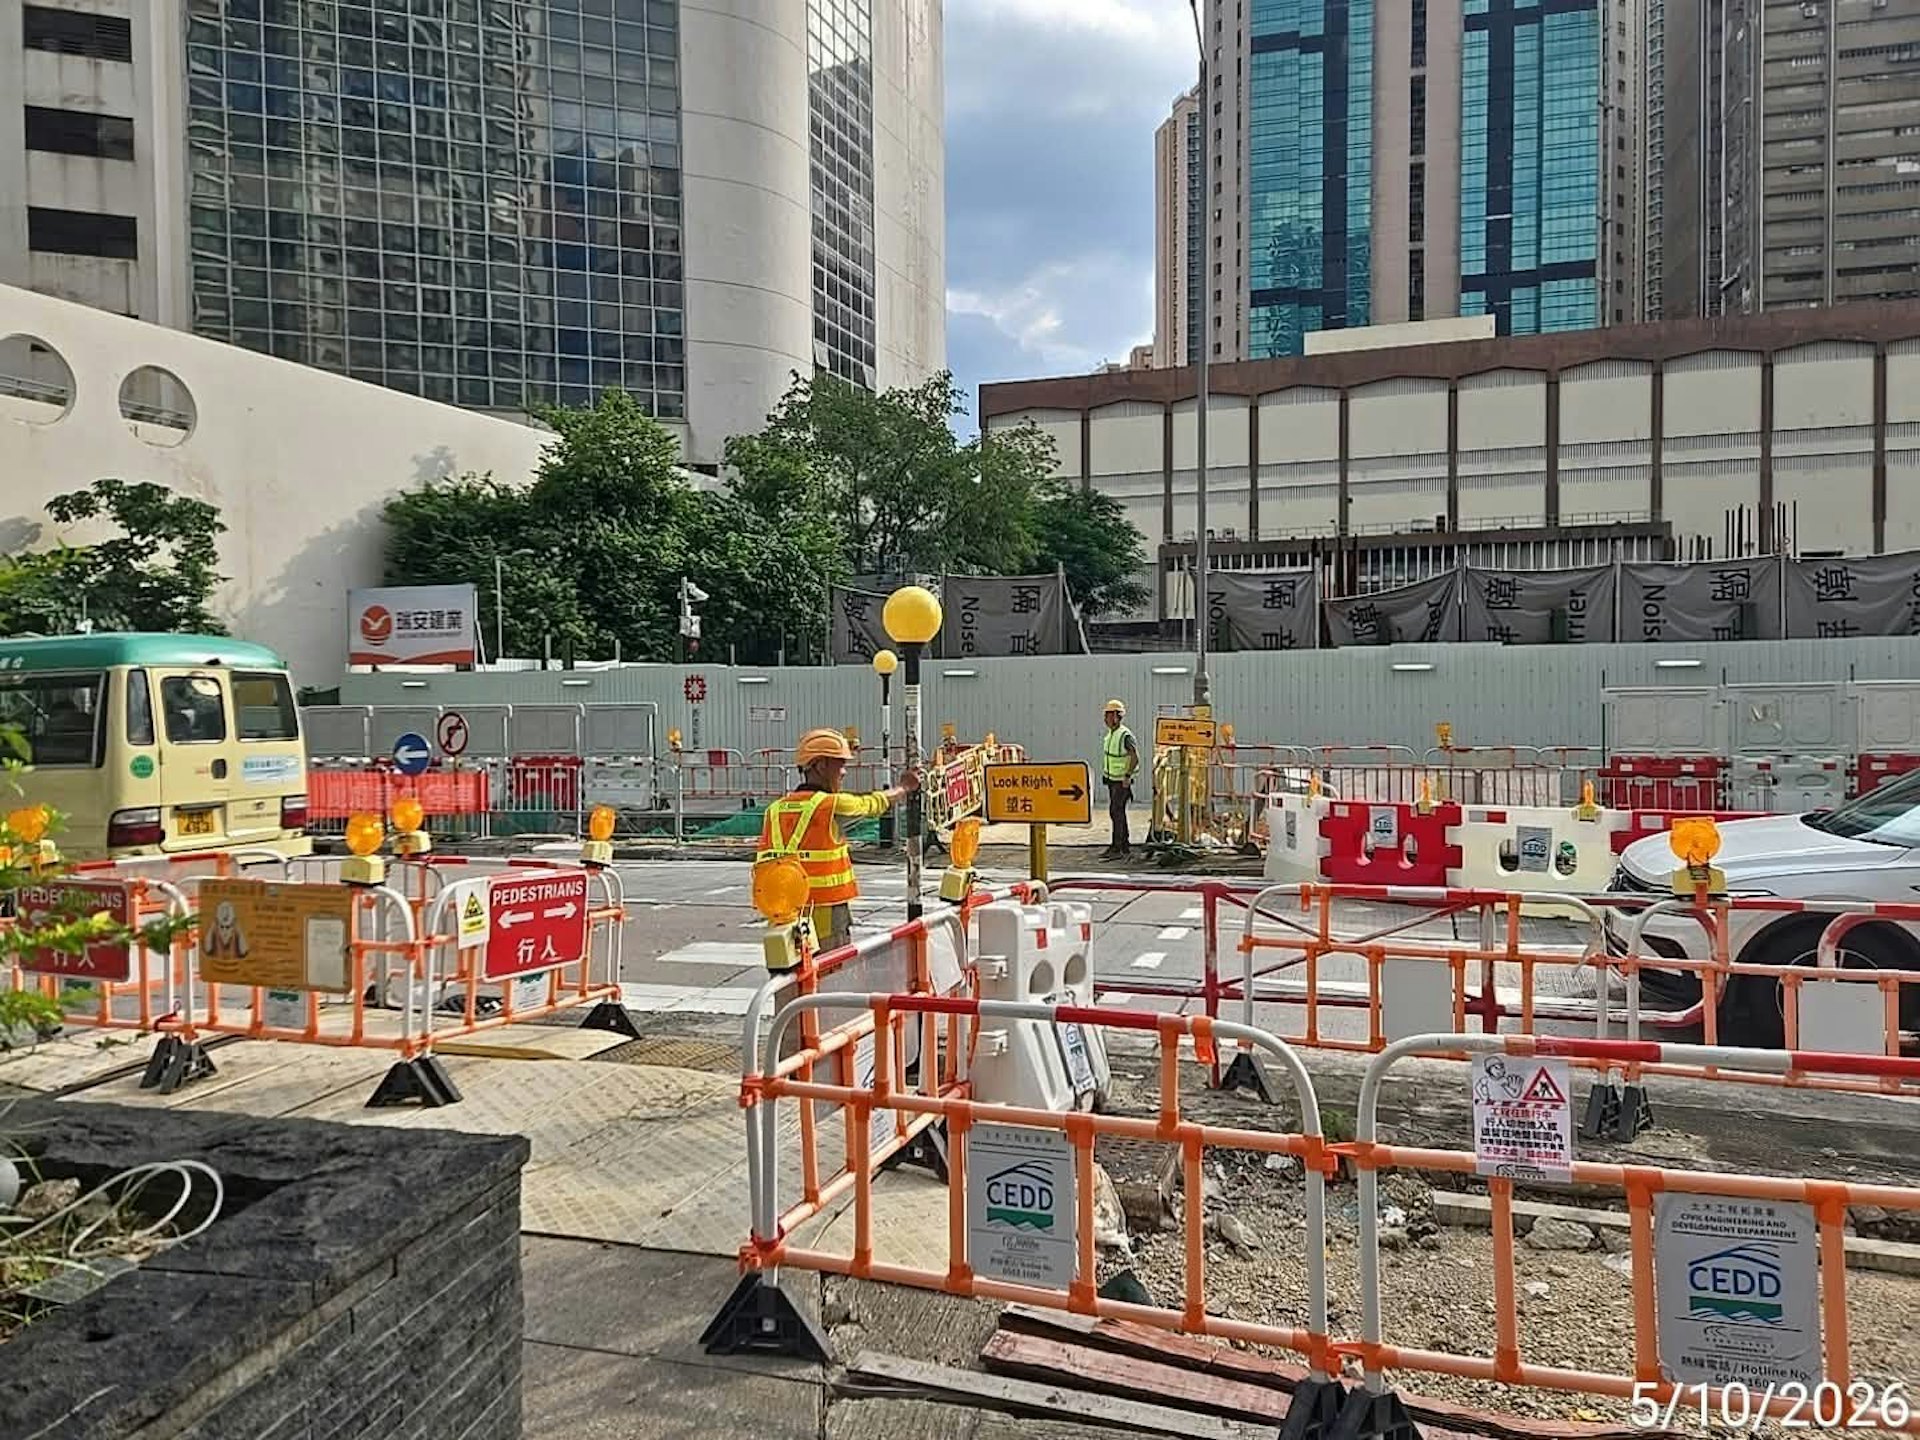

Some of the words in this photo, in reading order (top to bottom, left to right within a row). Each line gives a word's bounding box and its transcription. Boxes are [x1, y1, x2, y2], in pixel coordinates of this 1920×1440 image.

[961, 597, 980, 654] Noise
[1643, 584, 1667, 641] Nois
[992, 776, 1019, 788] Look
[1022, 775, 1053, 790] Right
[492, 881, 584, 906] PEDESTRIANS
[517, 934, 558, 964] 行人
[986, 1181, 1053, 1211] CEDD
[1672, 1221, 1736, 1234] DEVELOPMENT
[1737, 1227, 1798, 1238] DEPARTMENT
[1680, 1213, 1704, 1222] CIVIL
[1704, 1215, 1764, 1228] ENGINEERING
[1767, 1220, 1787, 1229] AND
[1689, 1266, 1781, 1298] CEDD
[1741, 1363, 1787, 1378] Hotline
